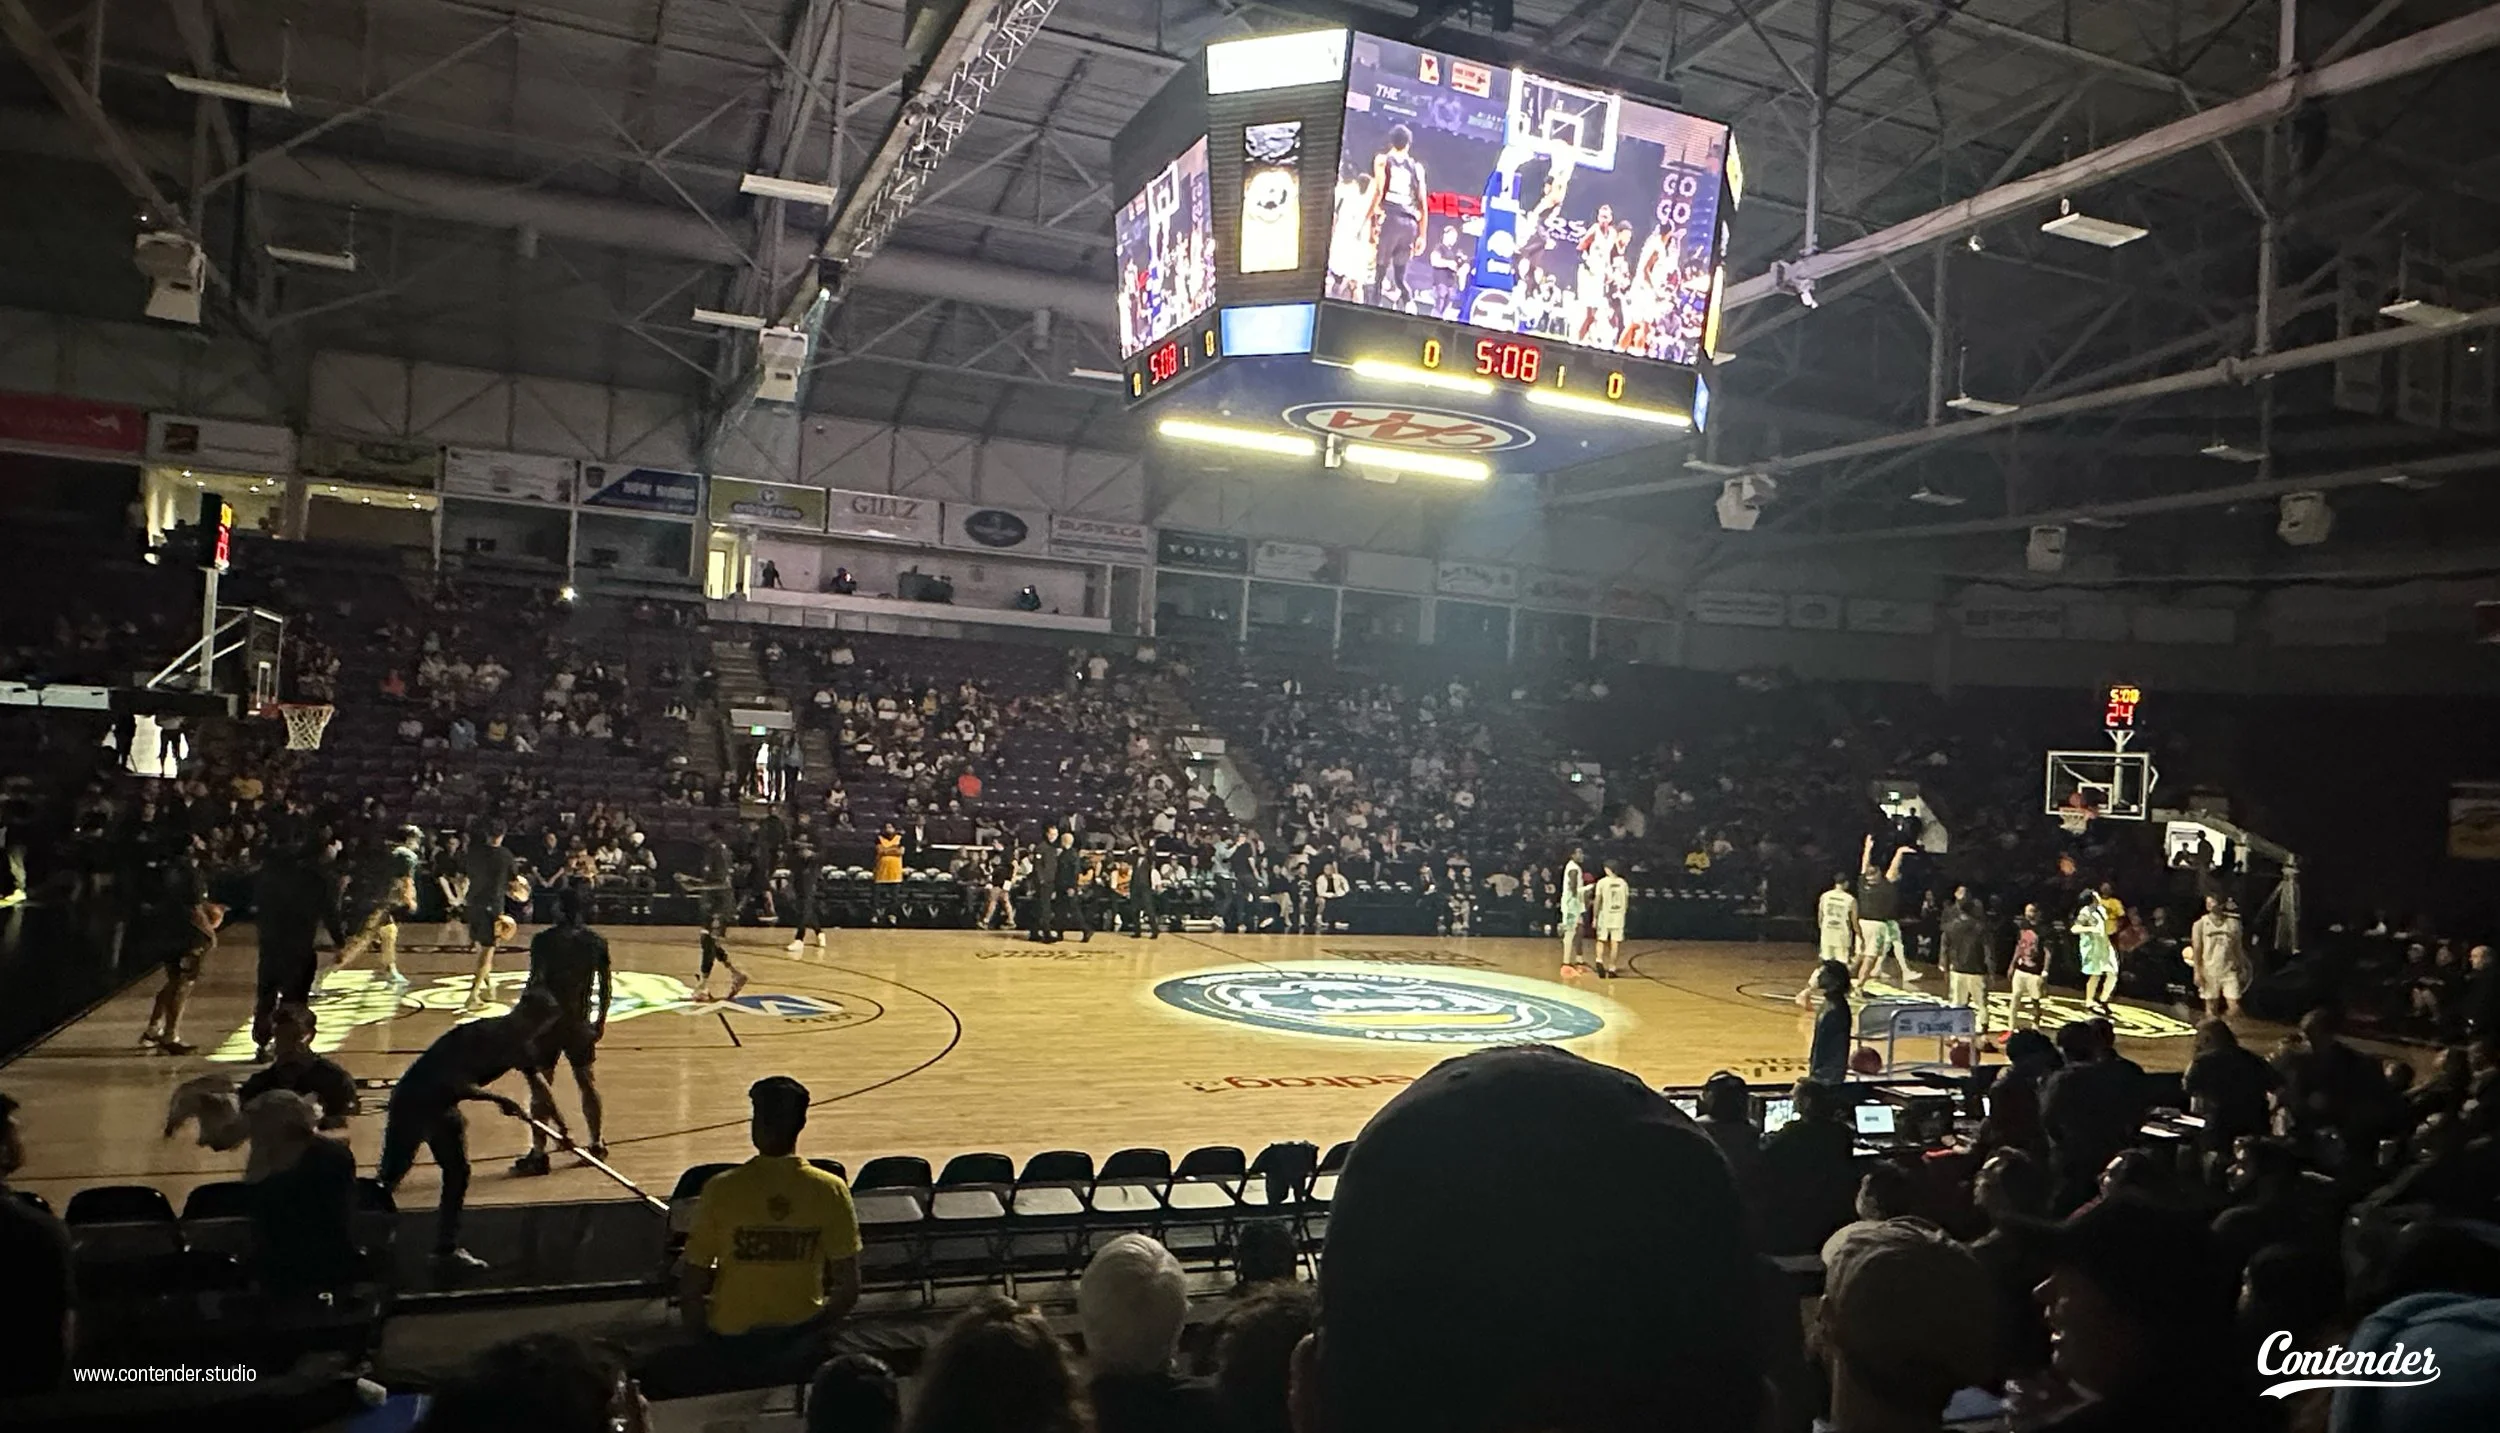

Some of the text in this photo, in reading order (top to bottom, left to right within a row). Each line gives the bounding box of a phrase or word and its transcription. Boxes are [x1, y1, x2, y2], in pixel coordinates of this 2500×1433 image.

[1663, 173, 1697, 197] GO
[1656, 198, 1691, 224] GO
[1423, 339, 1625, 399] 0 5:08 1 0
[852, 495, 923, 519] GILLZ
[2106, 703, 2134, 727] 24
[733, 1226, 822, 1262] SECURITY
